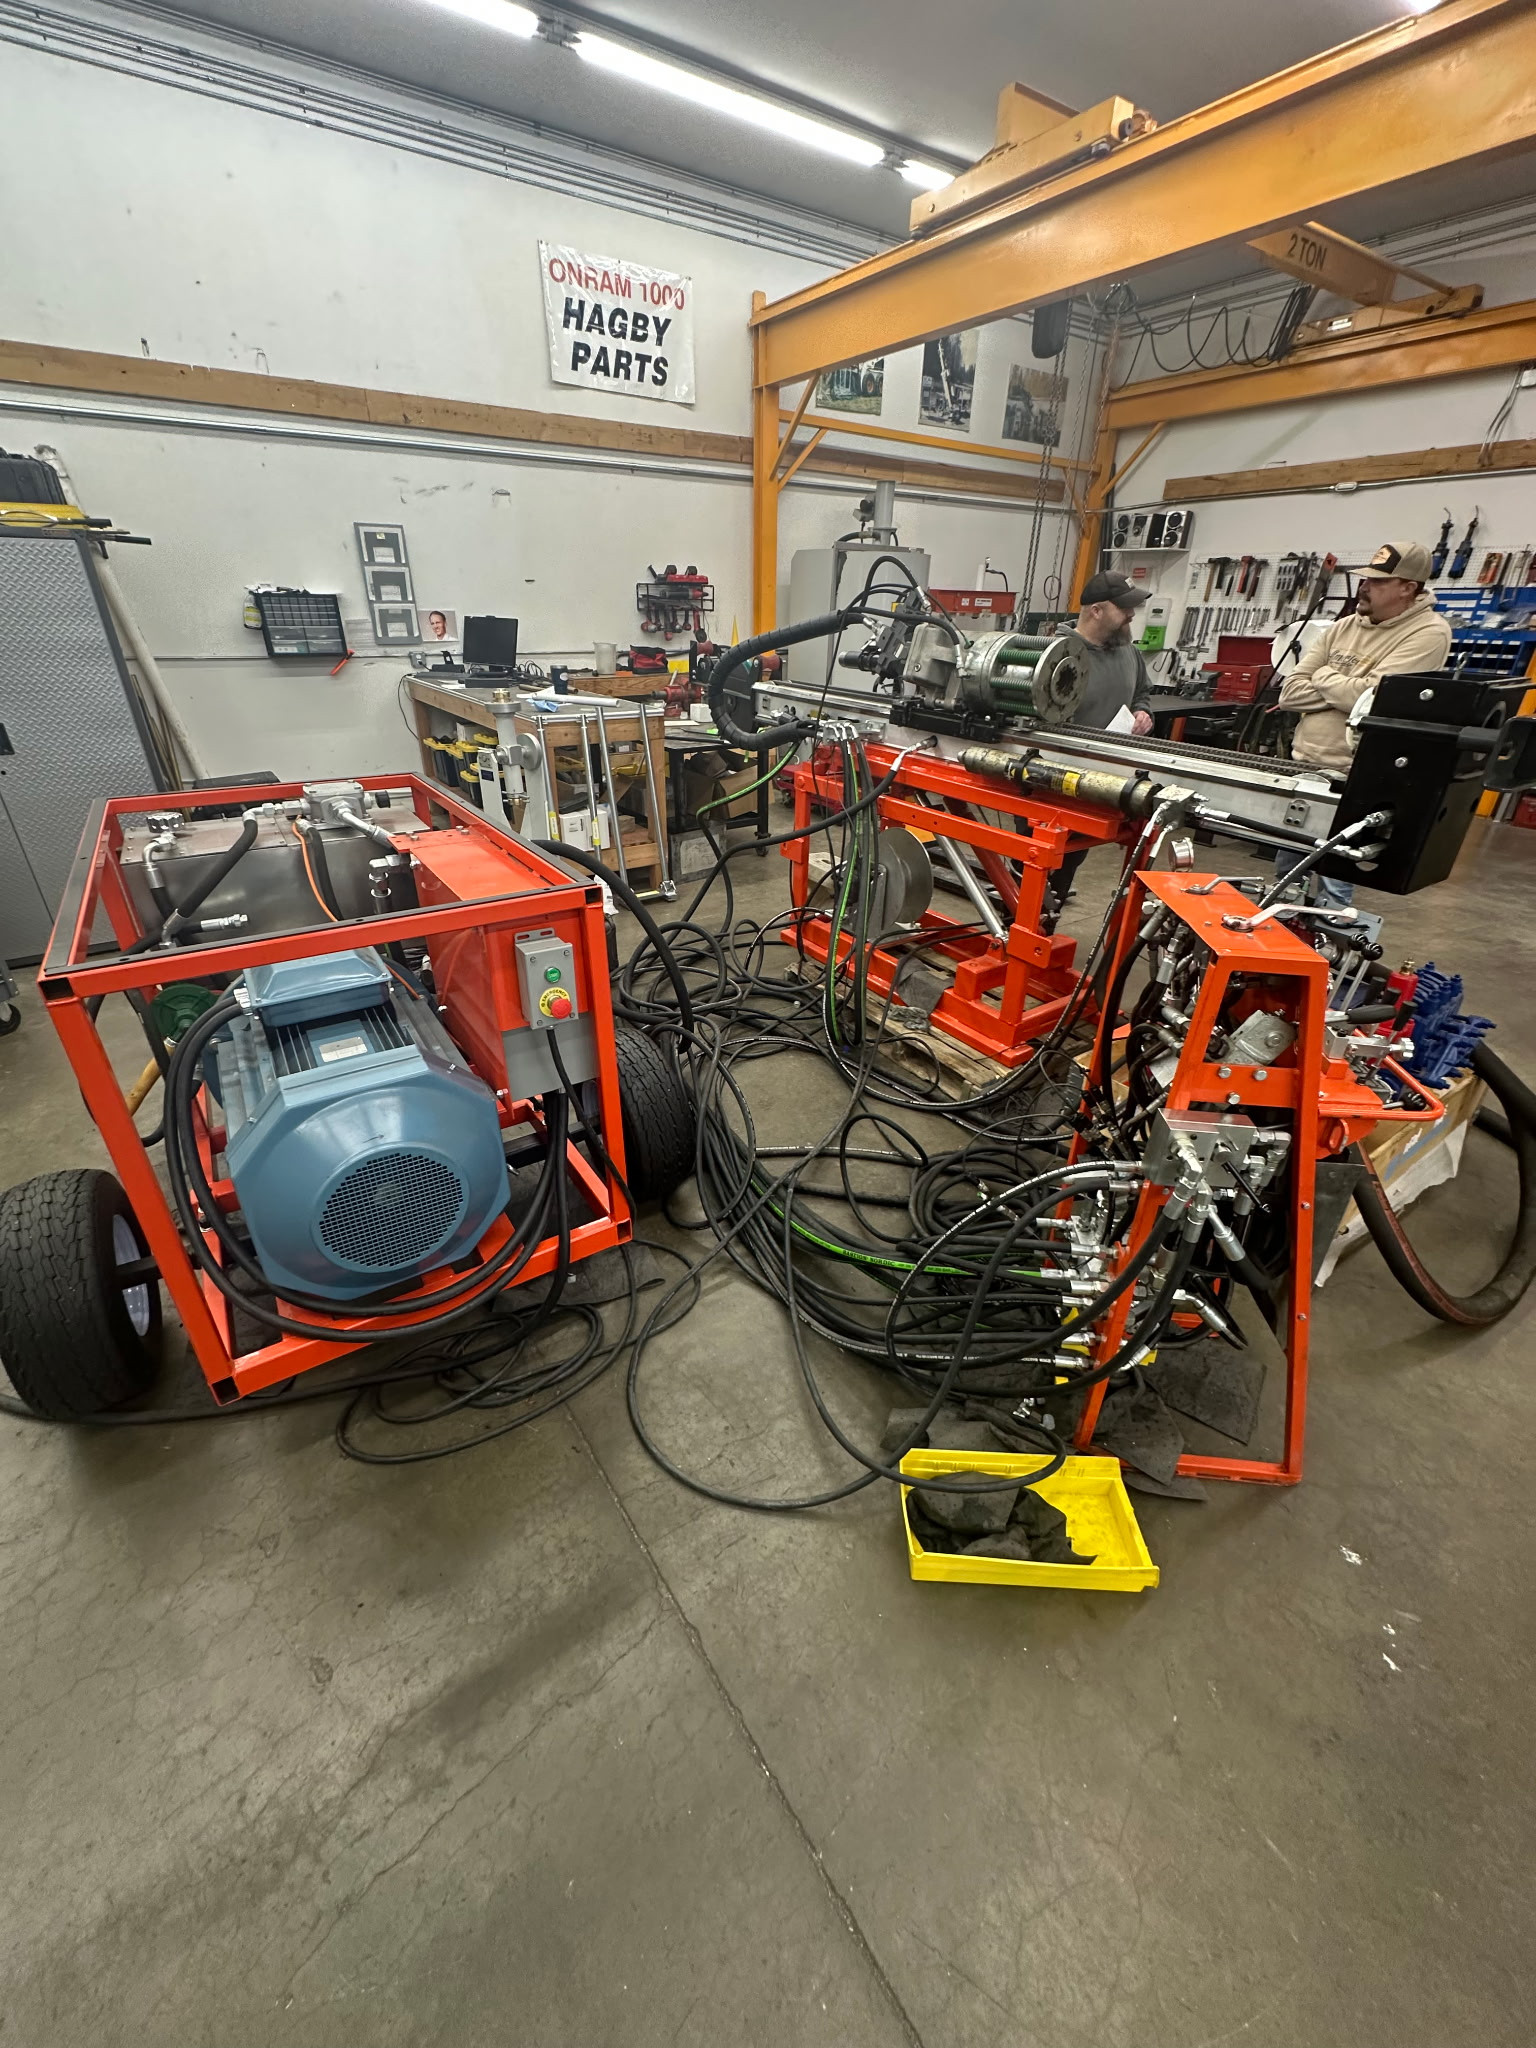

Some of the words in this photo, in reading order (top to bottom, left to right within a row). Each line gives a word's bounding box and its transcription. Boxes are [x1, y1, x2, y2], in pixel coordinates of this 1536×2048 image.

[1287, 234, 1299, 259] 2
[1300, 237, 1329, 271] TON
[548, 258, 632, 299] ONRAM
[639, 281, 686, 310] 1000
[562, 297, 672, 347] HAGBY
[570, 341, 669, 387] PARTS
[541, 988, 568, 1002] EMERGENCY
